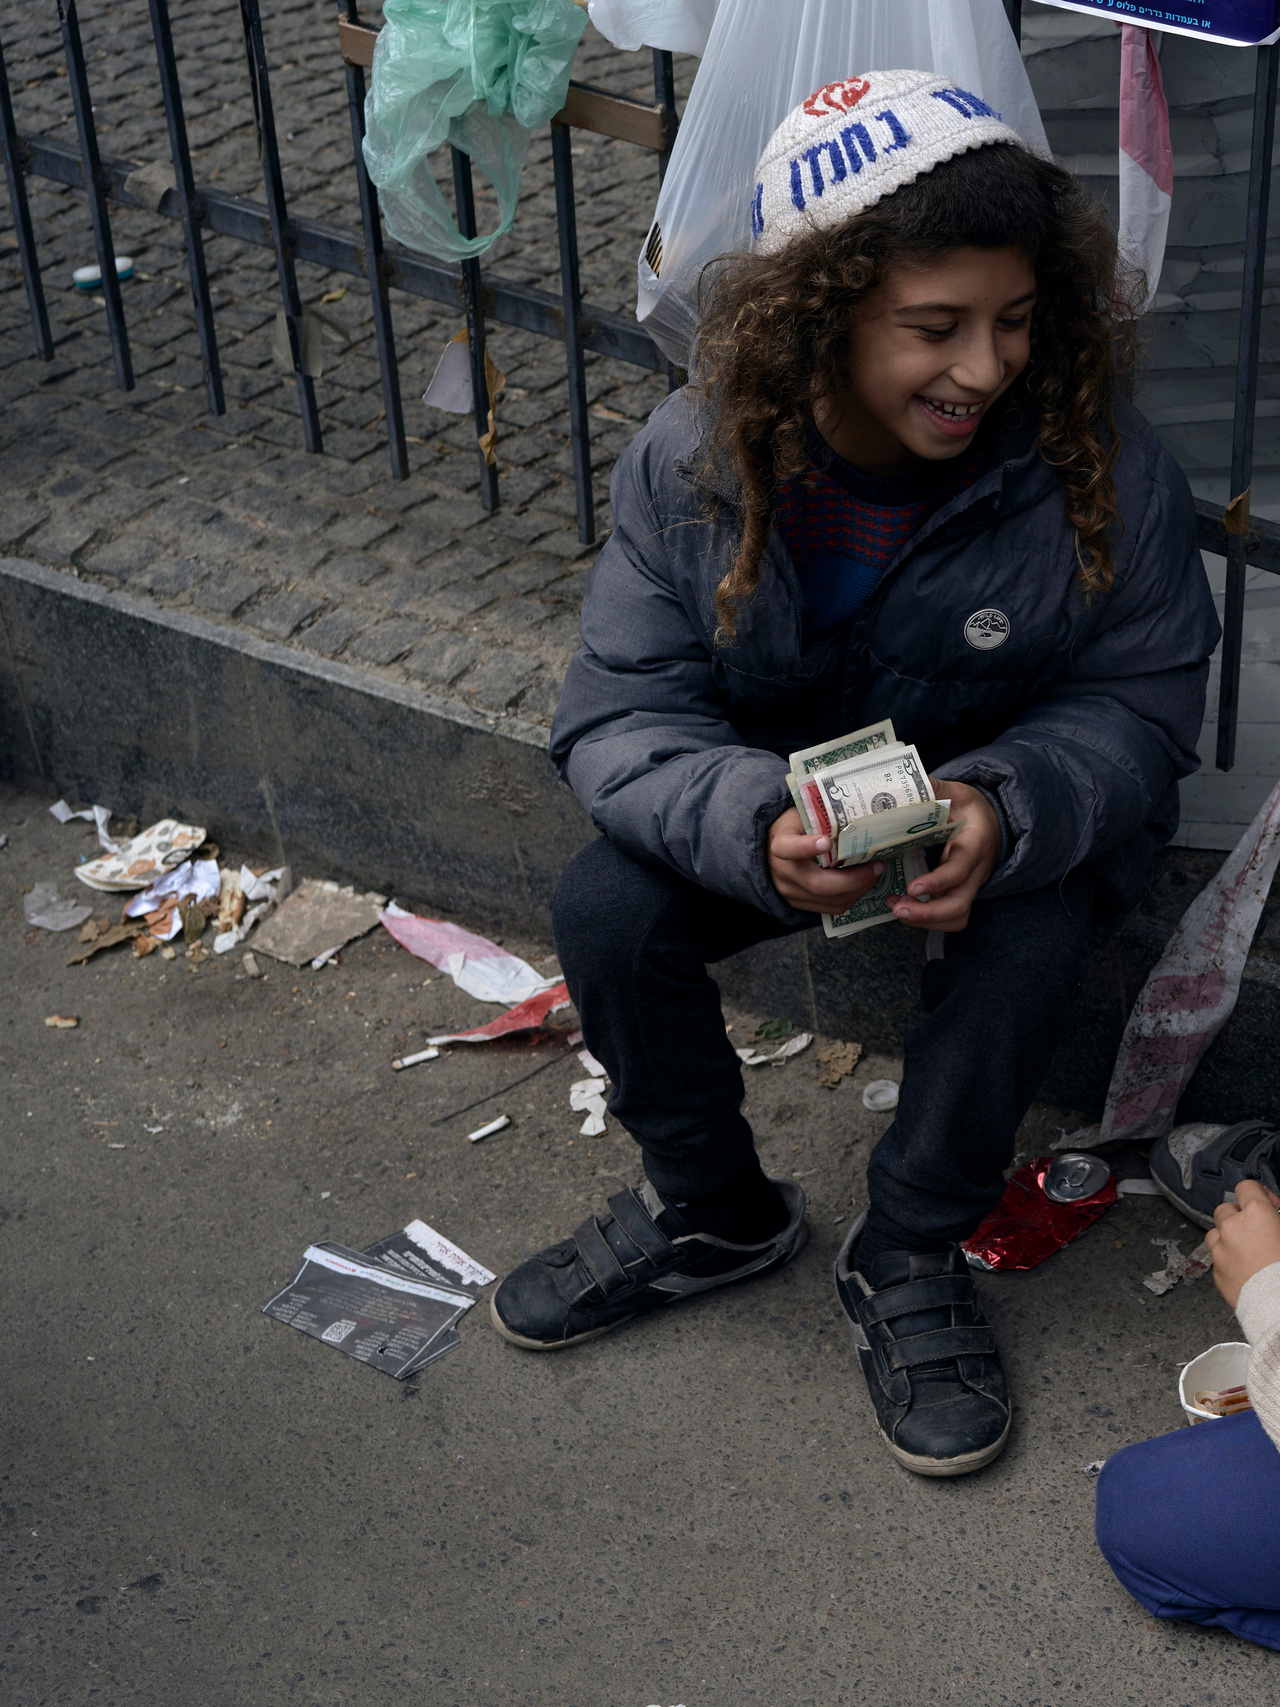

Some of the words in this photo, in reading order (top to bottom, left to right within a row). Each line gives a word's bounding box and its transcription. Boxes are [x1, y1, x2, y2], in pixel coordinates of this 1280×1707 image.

[1116, 1, 1136, 12] פלוס
[1138, 6, 1163, 18] נדרים
[1165, 12, 1199, 26] בעמדות
[1201, 20, 1211, 28] או
[789, 109, 913, 212] נחמן
[883, 771, 893, 782] B2
